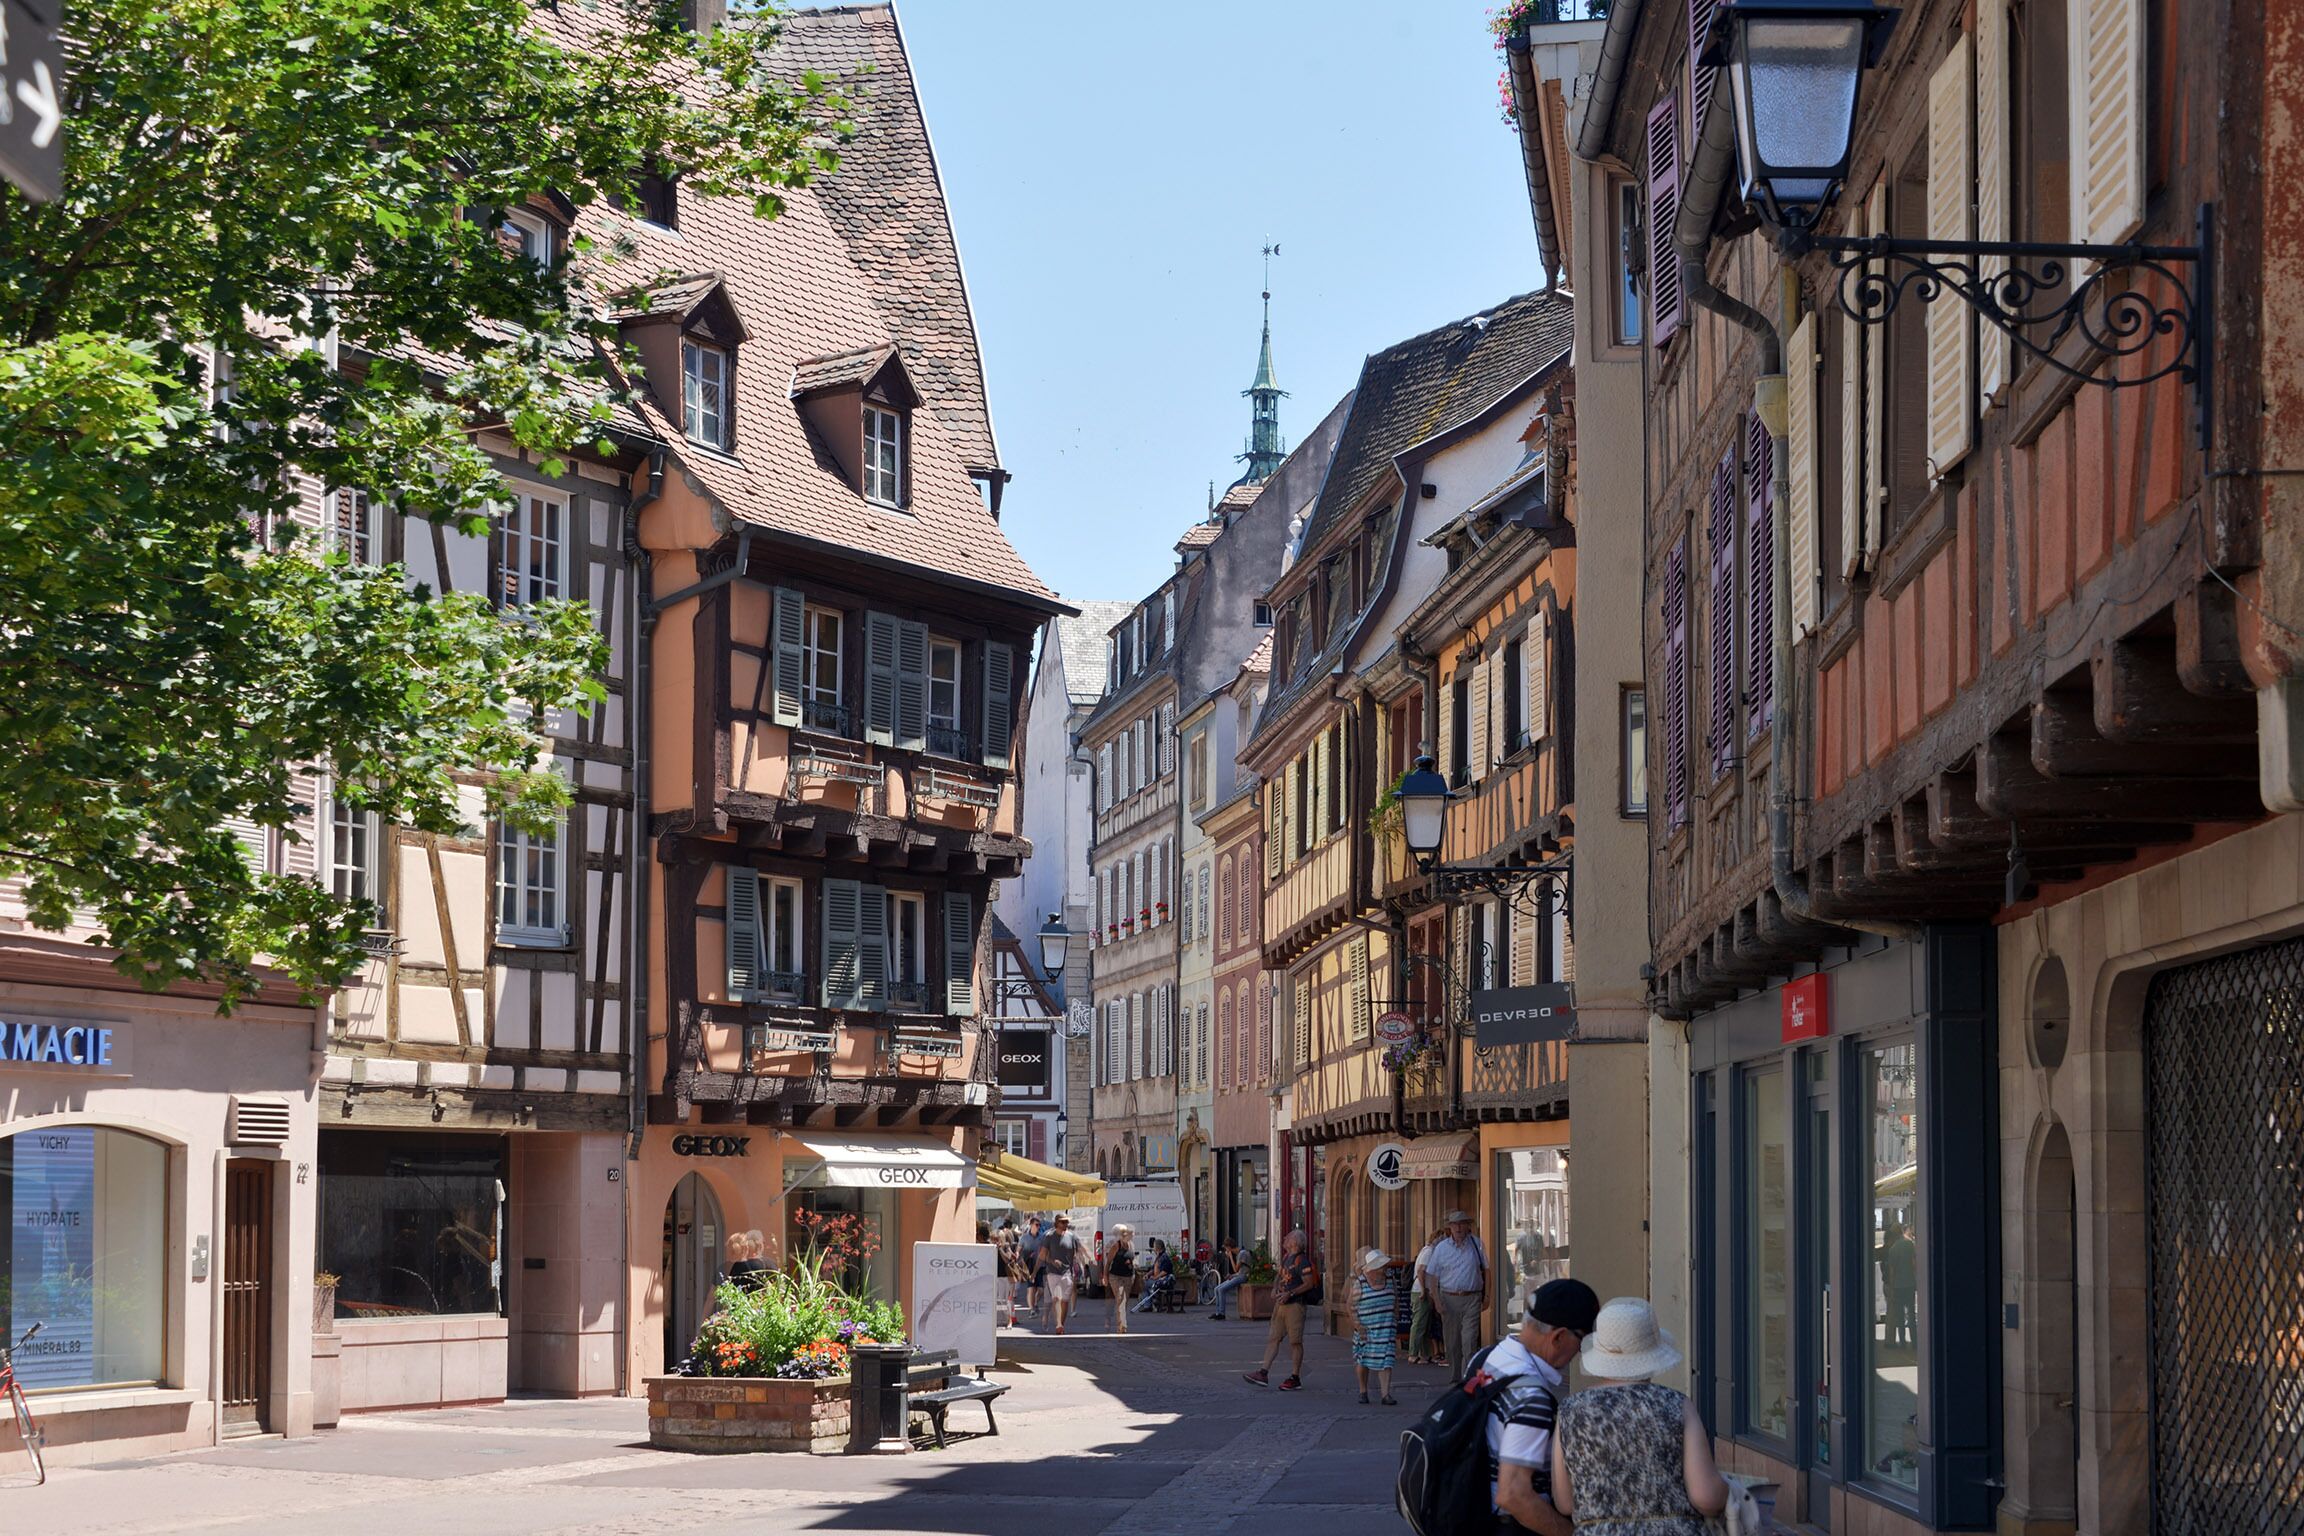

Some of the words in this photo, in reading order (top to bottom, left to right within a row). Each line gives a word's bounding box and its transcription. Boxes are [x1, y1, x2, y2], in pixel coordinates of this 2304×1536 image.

[1001, 1054, 1042, 1064] GEOX
[39, 1136, 70, 1149] VICHY
[672, 1134, 751, 1157] GEOX
[609, 1170, 619, 1180] 20
[879, 1167, 929, 1184] GEOX
[1372, 1168, 1388, 1184] PETIT
[26, 1212, 80, 1226] HYDRATE
[930, 1258, 979, 1269] GEOX
[23, 1338, 68, 1356] MINÉRAL
[69, 1340, 81, 1353] 89
